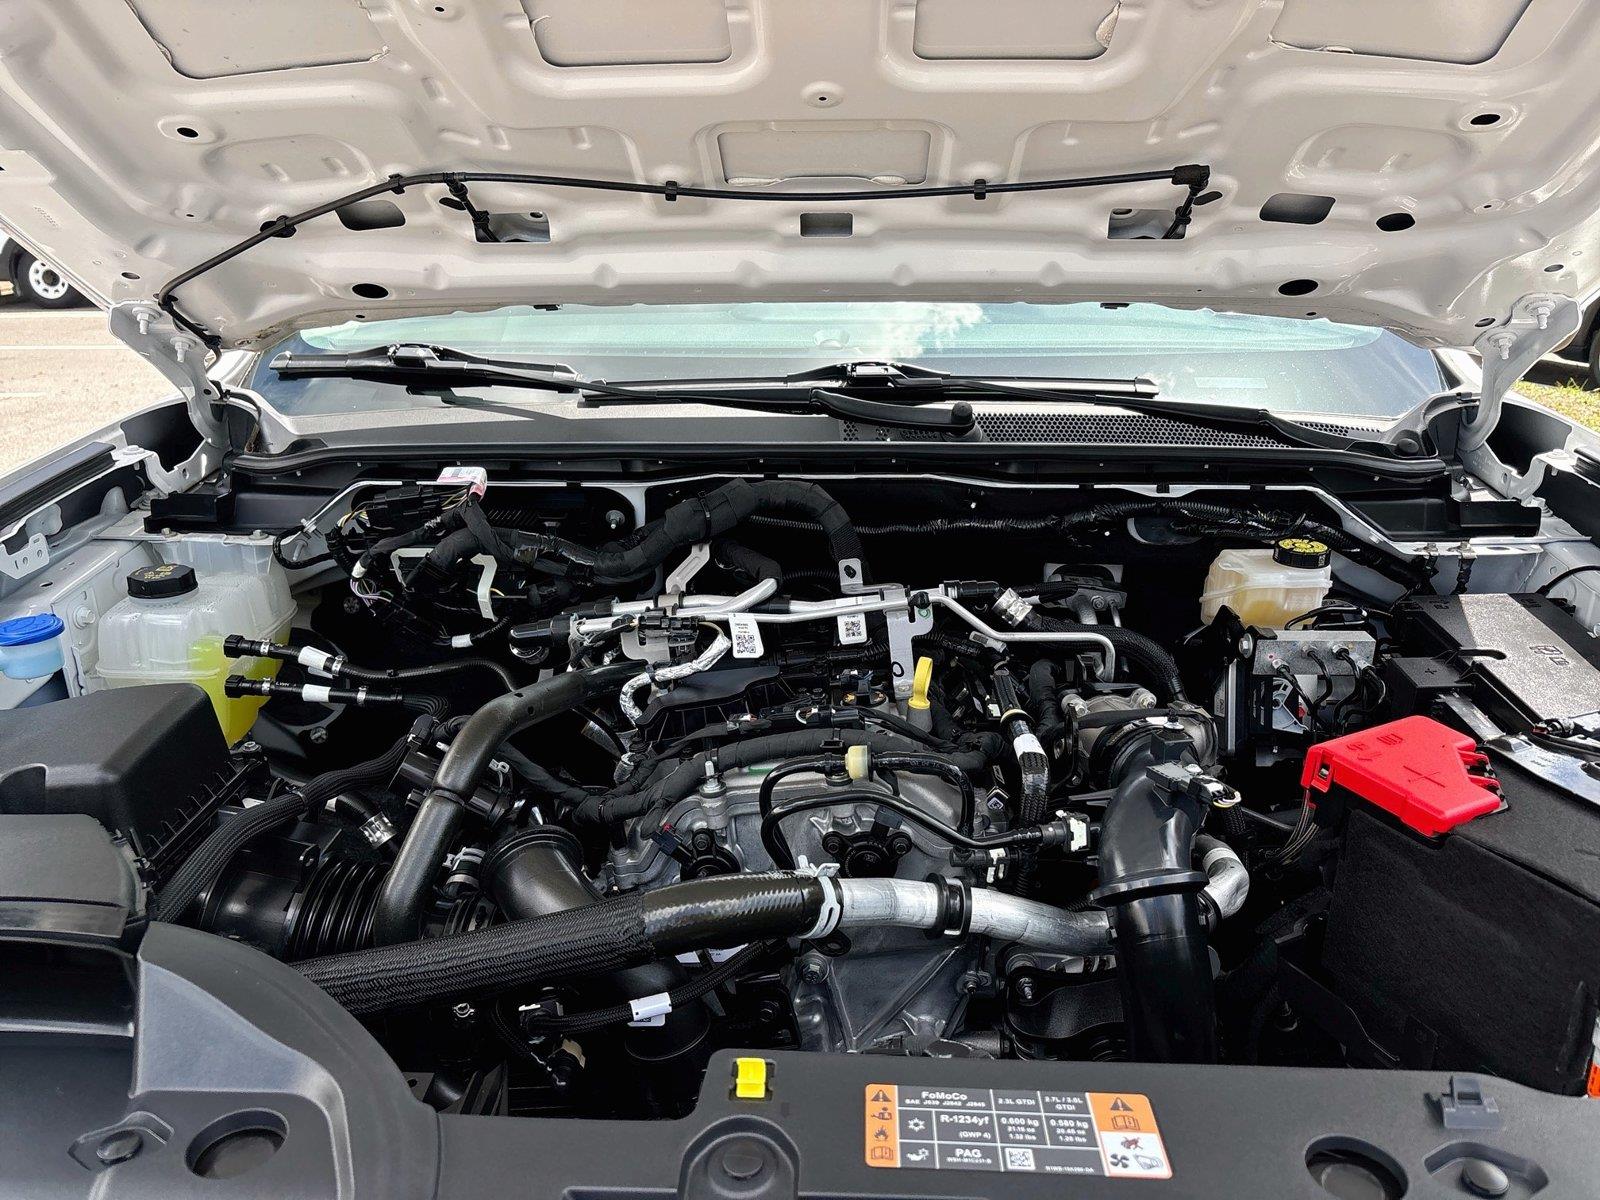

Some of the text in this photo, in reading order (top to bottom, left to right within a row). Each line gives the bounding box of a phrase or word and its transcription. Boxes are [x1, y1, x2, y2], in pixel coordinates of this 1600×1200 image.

[922, 1091, 968, 1100] FoMoCo
[940, 1114, 989, 1126] R-1234yf
[1027, 1118, 1039, 1127] kg
[1076, 1120, 1088, 1129] kg
[955, 1148, 982, 1158] PAG
